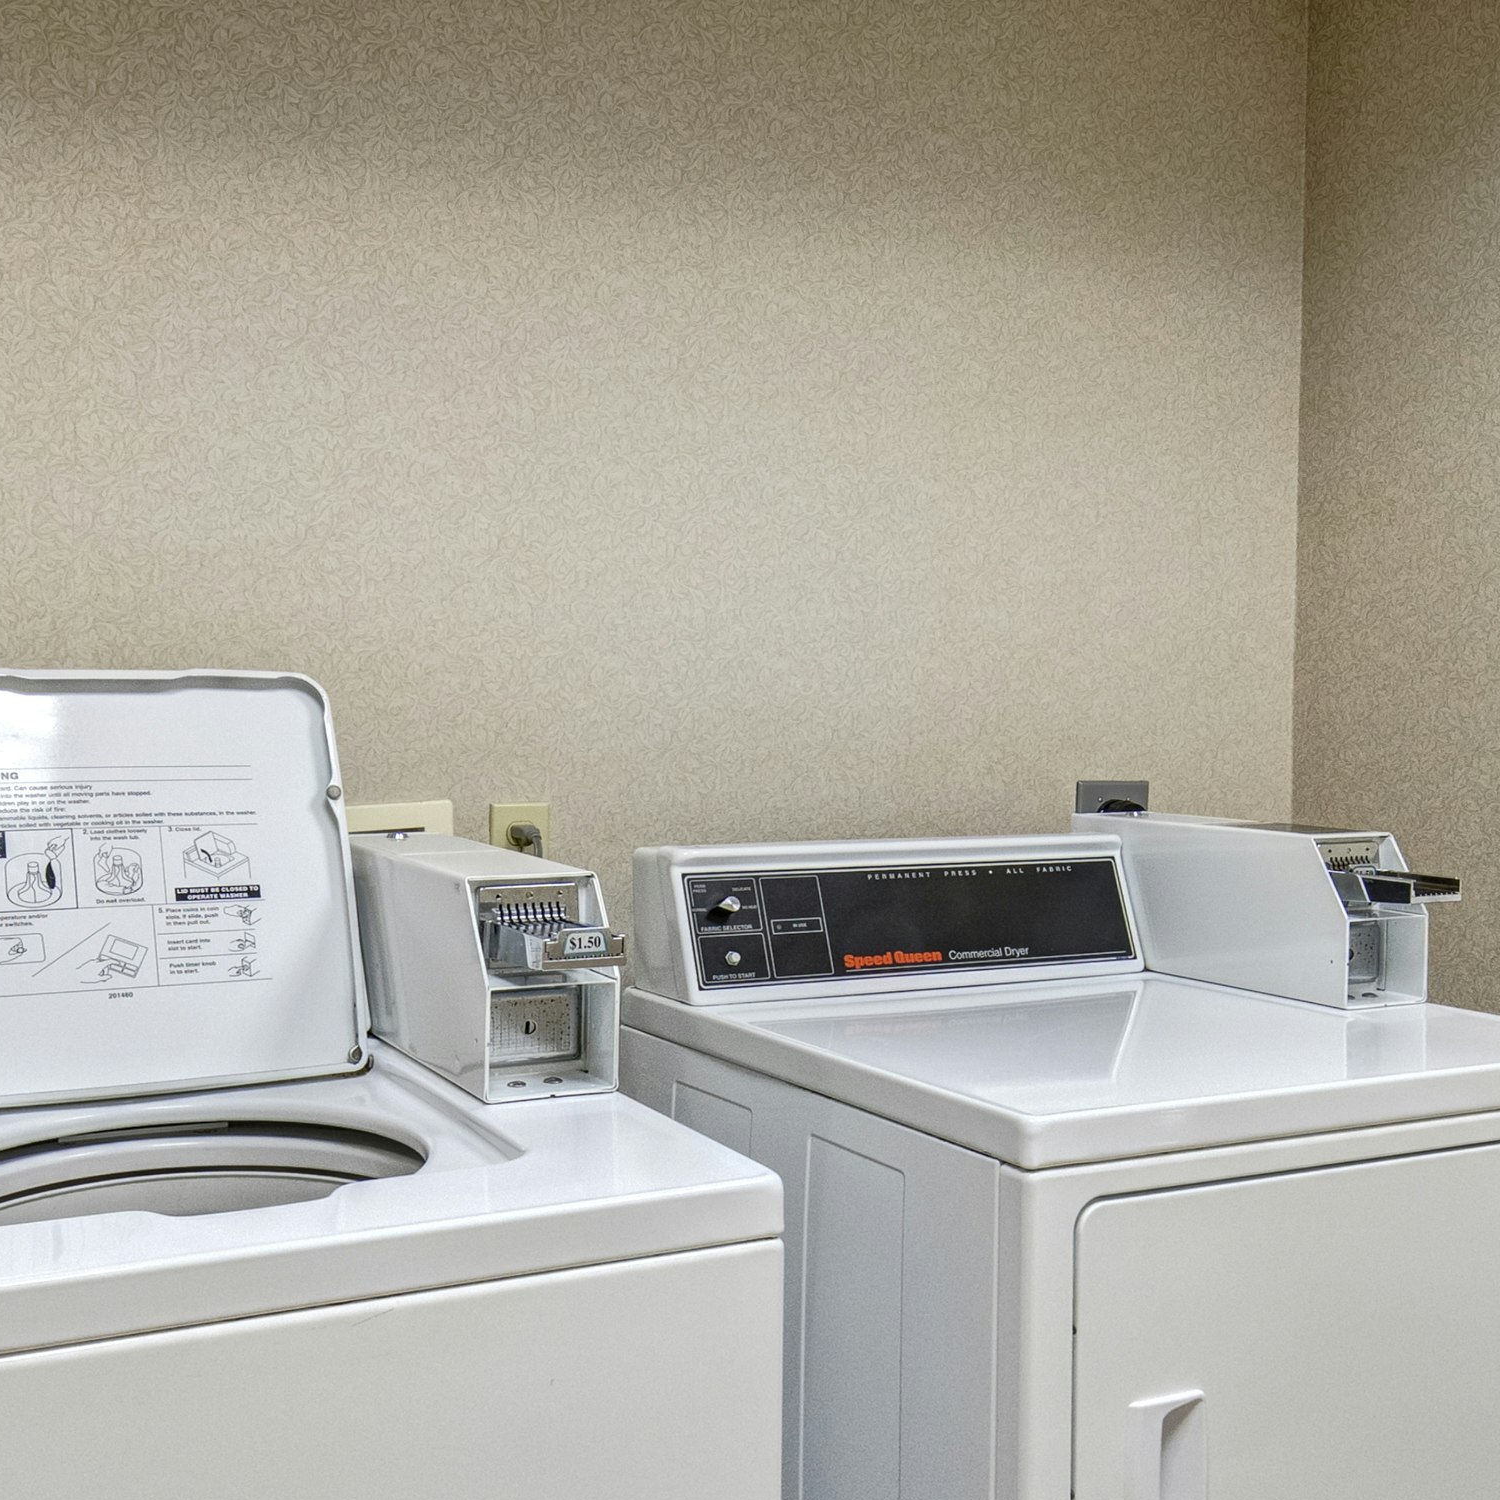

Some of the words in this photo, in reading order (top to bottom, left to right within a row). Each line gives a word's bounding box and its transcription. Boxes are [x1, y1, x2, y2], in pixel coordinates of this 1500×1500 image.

[867, 871, 931, 881] PERMANENT
[943, 869, 978, 877] PRESS
[1036, 865, 1073, 873] FABRIC
[569, 936, 601, 950] $1.50
[843, 951, 893, 969] Speed
[894, 950, 943, 964] Queen
[948, 947, 1003, 960] Commercial
[1004, 946, 1030, 959] Dryer
